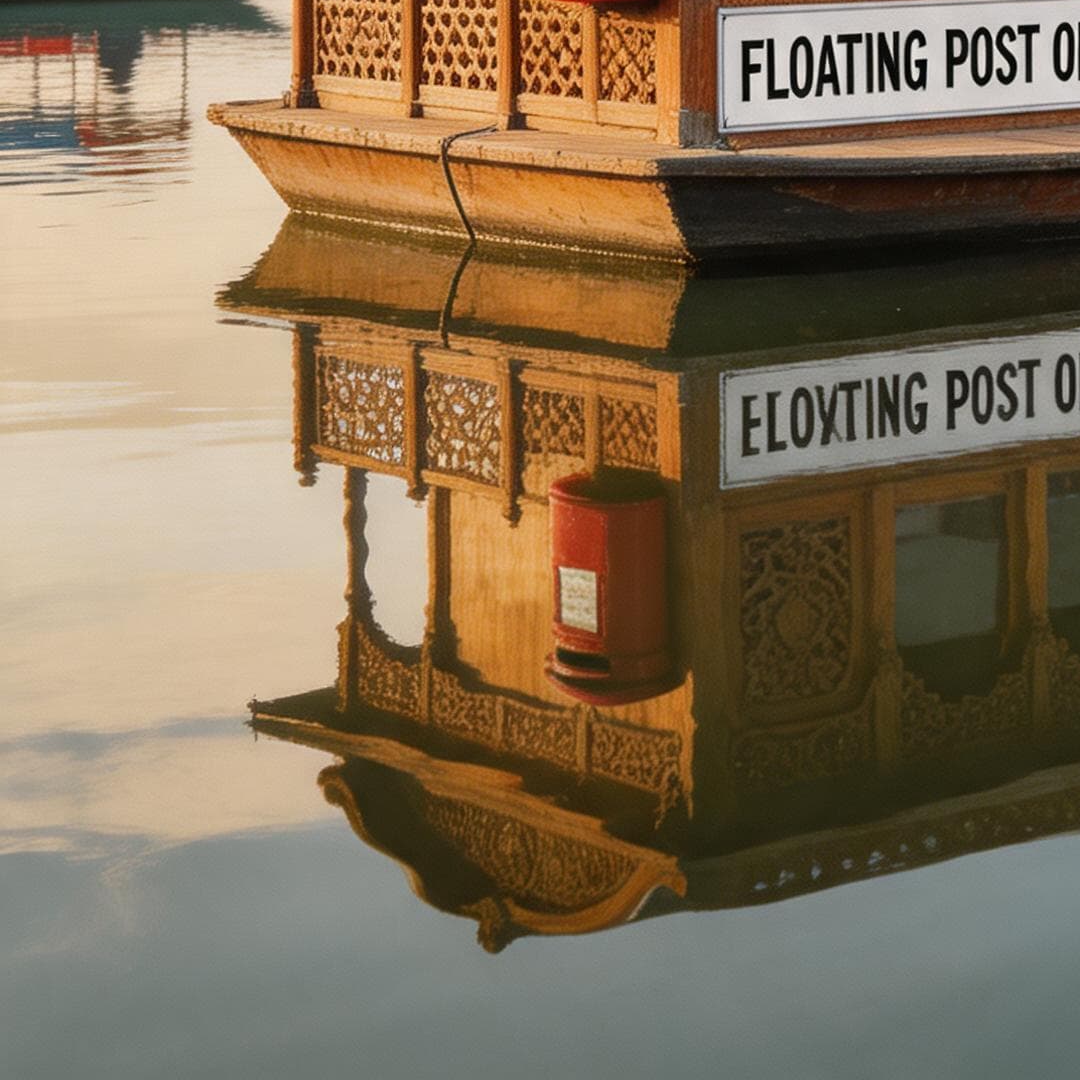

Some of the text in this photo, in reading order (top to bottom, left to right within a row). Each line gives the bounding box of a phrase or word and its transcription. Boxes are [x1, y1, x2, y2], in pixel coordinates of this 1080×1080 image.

[741, 29, 928, 102] FLOATING
[945, 23, 1041, 89] POST
[945, 358, 1041, 431] POST
